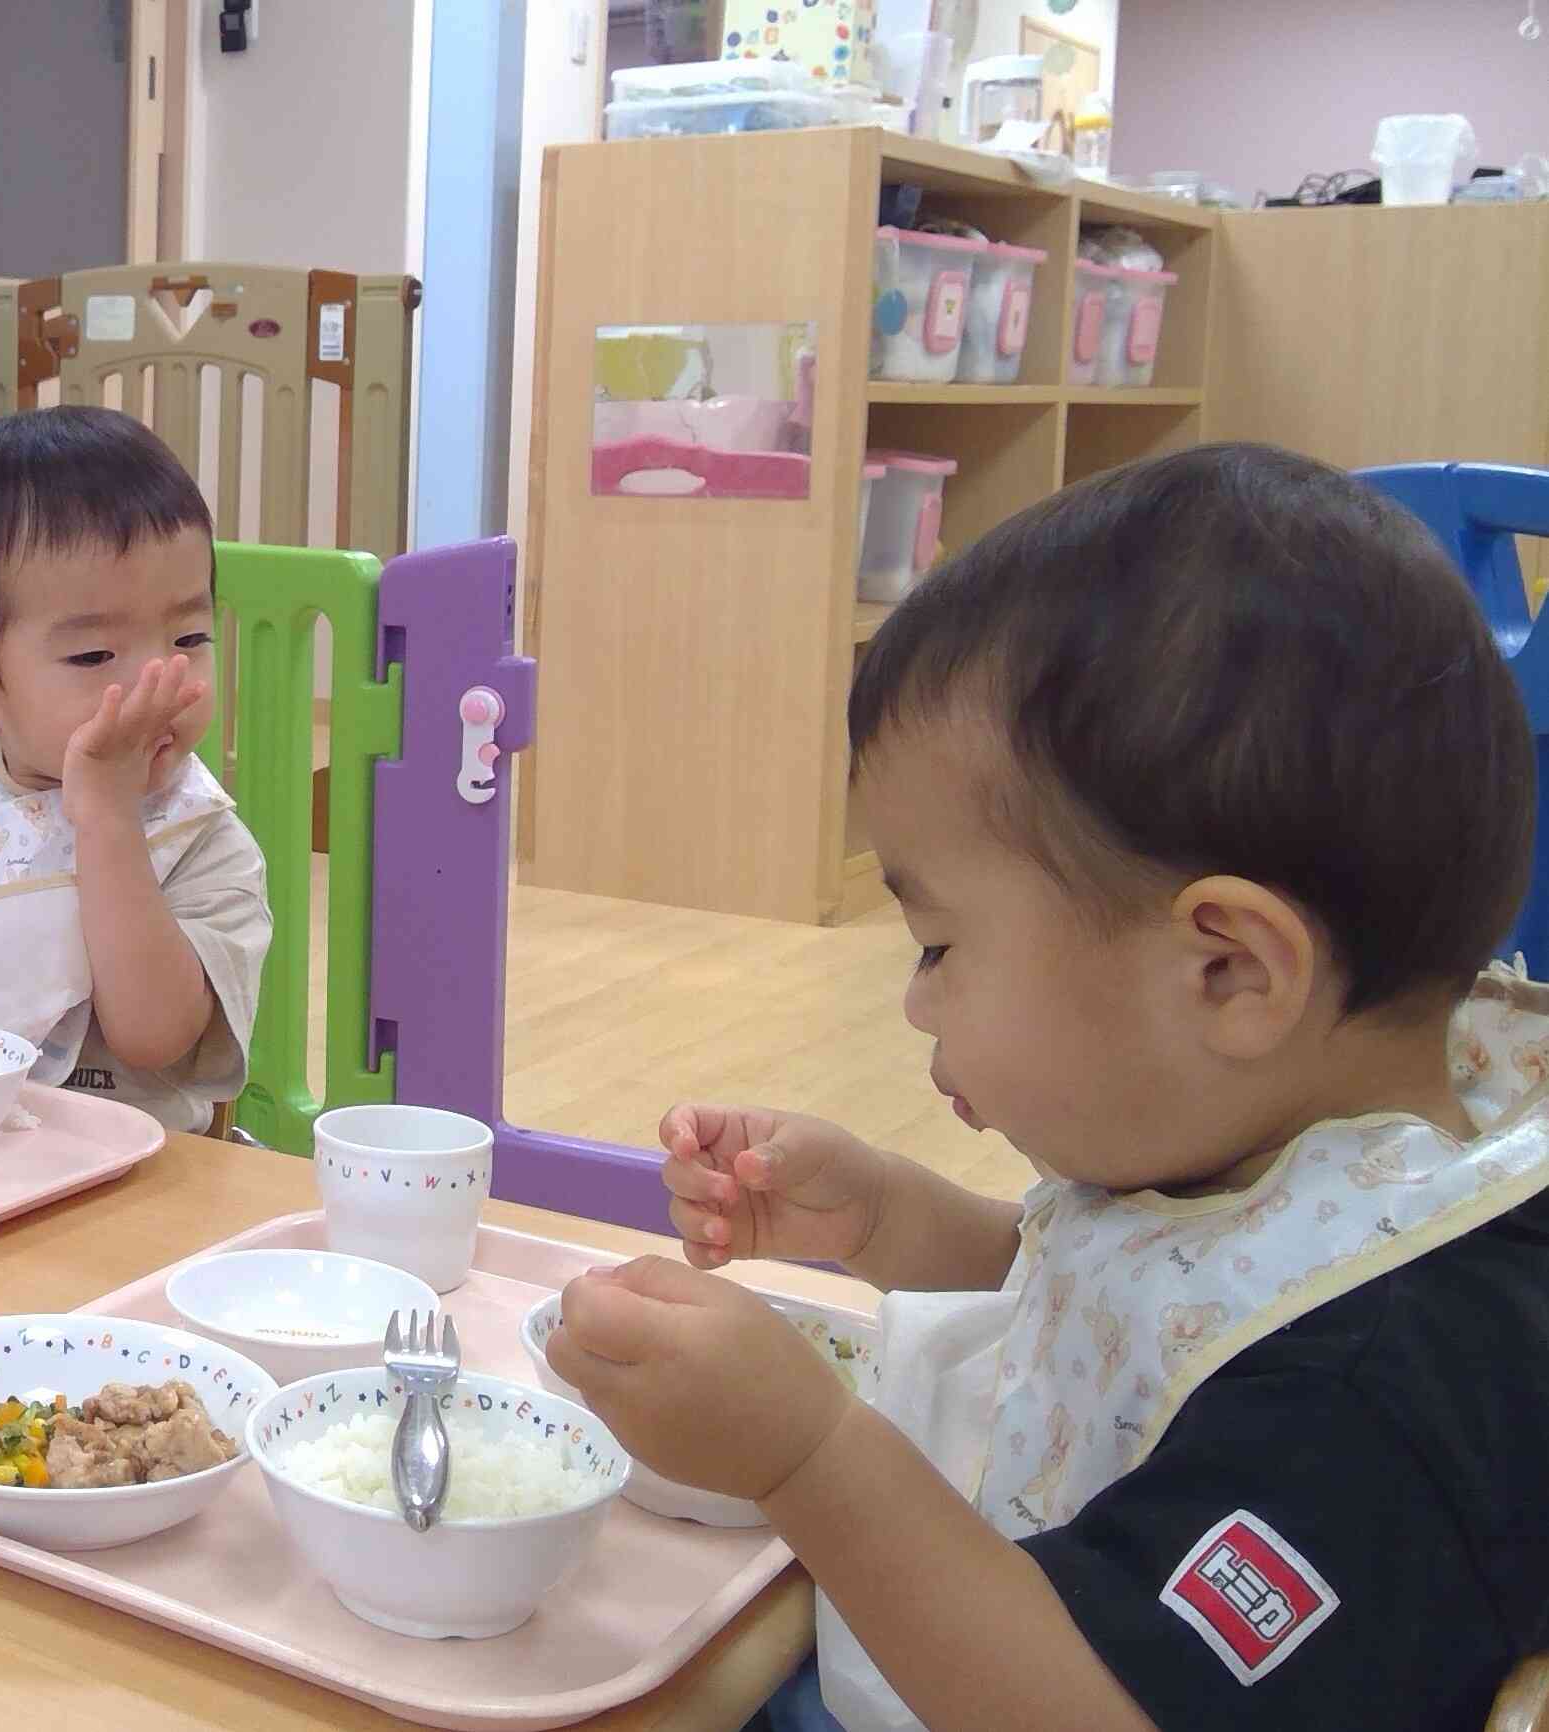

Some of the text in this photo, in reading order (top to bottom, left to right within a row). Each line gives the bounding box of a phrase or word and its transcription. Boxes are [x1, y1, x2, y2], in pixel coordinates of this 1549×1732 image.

[381, 1169, 391, 1183] V
[425, 1175, 441, 1190] W
[62, 1338, 76, 1355] A
[101, 1333, 113, 1349] B
[137, 1350, 151, 1364] C
[179, 1354, 192, 1369] D
[213, 1367, 228, 1384] E
[279, 1407, 294, 1430] X
[302, 1391, 314, 1409] Y
[326, 1382, 343, 1403] Z
[375, 1388, 390, 1408] A
[440, 1393, 454, 1410] C
[477, 1393, 494, 1411] D
[515, 1400, 533, 1420] E
[544, 1423, 557, 1439] F
[570, 1426, 584, 1444] G
[1197, 1542, 1295, 1641] トミカ
